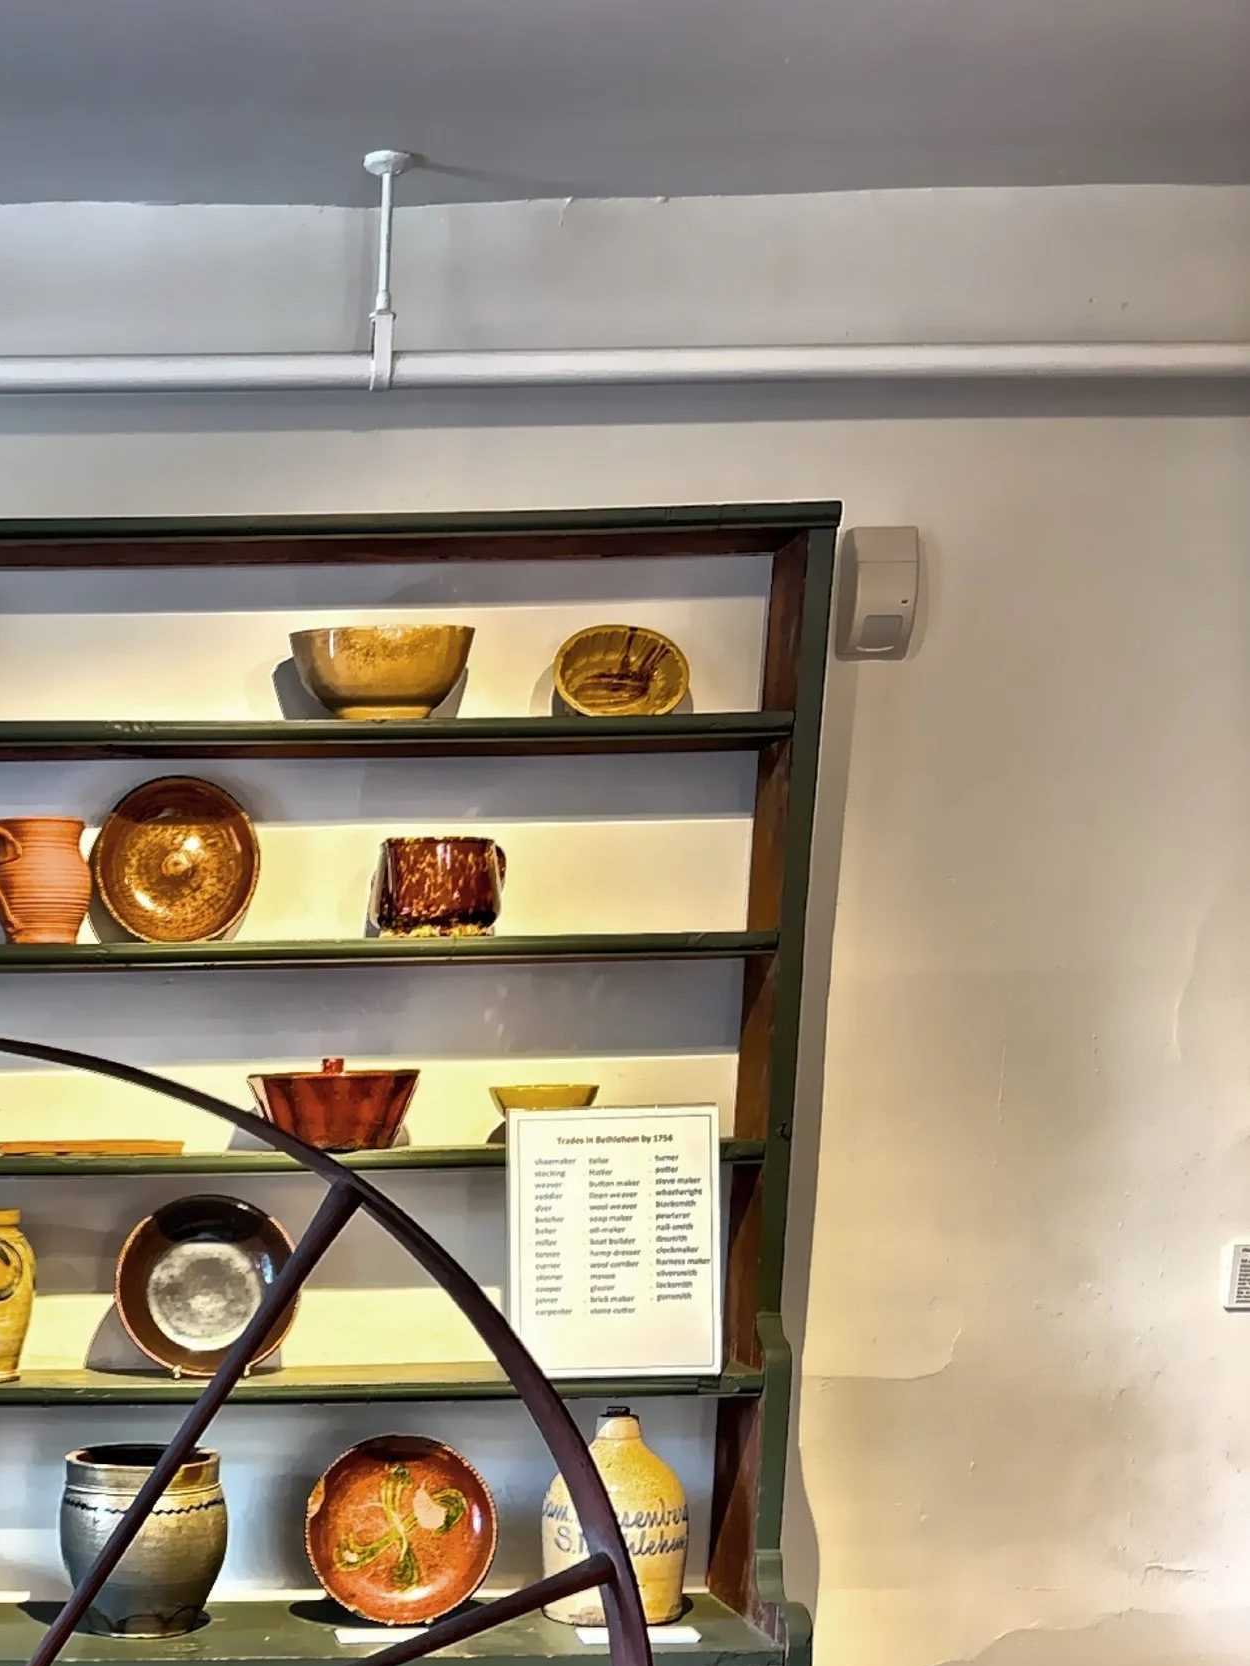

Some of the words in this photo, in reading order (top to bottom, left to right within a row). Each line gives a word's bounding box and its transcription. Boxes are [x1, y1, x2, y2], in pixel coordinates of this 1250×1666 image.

[557, 1136, 584, 1145] Trades
[586, 1136, 594, 1144] in
[595, 1135, 639, 1144] Bethlehem
[641, 1134, 652, 1144] by
[533, 1157, 577, 1166] shoemaker
[588, 1156, 610, 1166] tailor
[653, 1153, 680, 1163] turner
[533, 1170, 567, 1179] stocking
[654, 1165, 679, 1176] potter
[588, 1179, 616, 1189] button
[615, 1178, 641, 1188] maker
[675, 1175, 703, 1185] maker
[533, 1181, 563, 1190] weaver
[534, 1191, 564, 1201] saddler
[654, 1187, 703, 1199] wheelwright
[534, 1203, 553, 1214] dyer
[588, 1202, 609, 1212] wool
[655, 1199, 698, 1209] blacksmith
[534, 1215, 565, 1225] butcher
[588, 1214, 608, 1224] soap
[608, 1213, 634, 1223] maker
[534, 1227, 558, 1236] baker
[534, 1238, 558, 1247] miller
[607, 1236, 637, 1246] builder
[534, 1250, 561, 1259] tanner
[589, 1249, 613, 1260] hemp
[611, 1248, 642, 1257] dresser
[655, 1245, 700, 1255] clockmaker
[589, 1260, 610, 1269] wool
[655, 1258, 686, 1267] harness
[685, 1256, 711, 1266] maker
[655, 1268, 699, 1278] silversmith
[655, 1280, 694, 1290] locksmith
[534, 1285, 563, 1296] cooper
[589, 1295, 610, 1304] brick
[609, 1294, 636, 1304] maker
[655, 1291, 693, 1303] gunsmith
[534, 1308, 573, 1319] carpenter
[589, 1307, 612, 1316] stone
[612, 1306, 637, 1315] cutter
